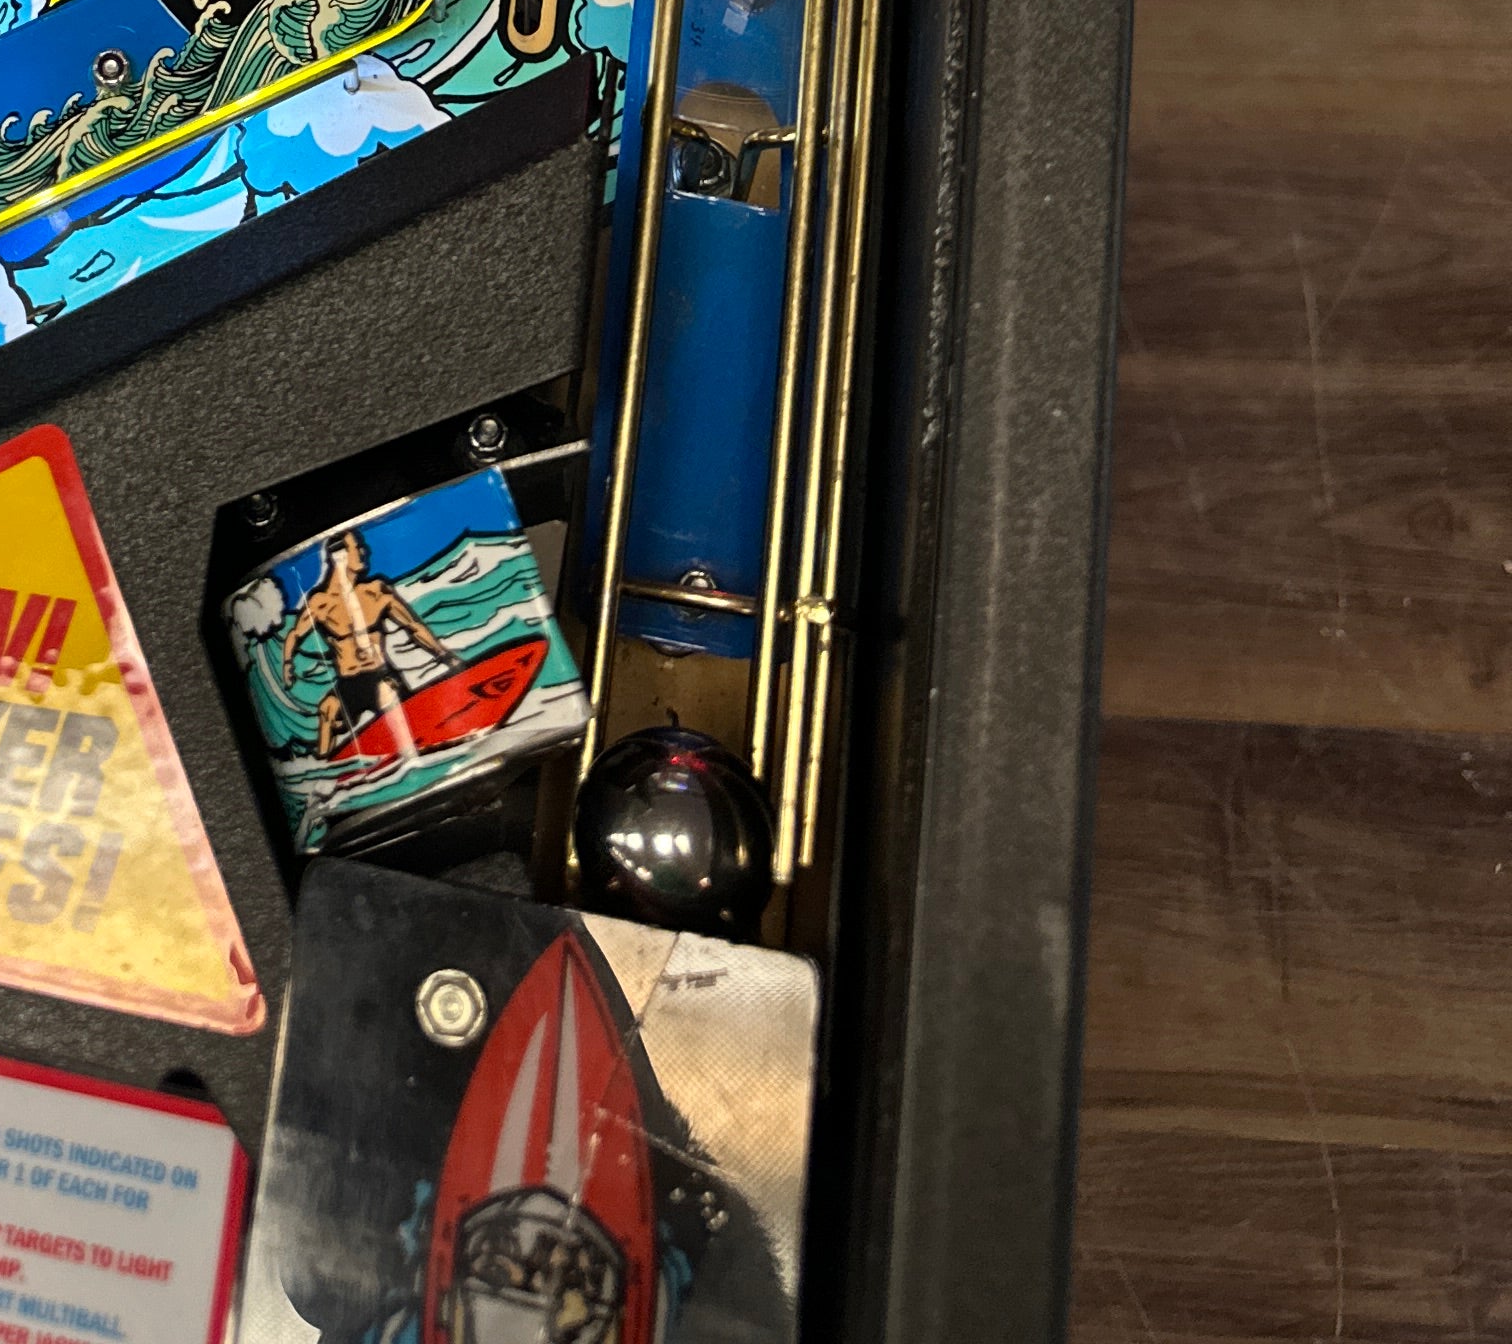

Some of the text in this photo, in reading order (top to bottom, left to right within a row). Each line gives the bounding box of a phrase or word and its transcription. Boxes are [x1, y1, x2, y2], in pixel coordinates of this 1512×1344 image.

[4, 1127, 65, 1160] SHOTS
[68, 1140, 166, 1184] INDICATED
[171, 1164, 199, 1190] ON
[30, 1166, 55, 1190] OF
[57, 1172, 110, 1202] EACH
[112, 1185, 151, 1212] FOR
[5, 1223, 86, 1265] TARGETS
[91, 1243, 113, 1269] TO
[116, 1250, 175, 1283] LIGHT
